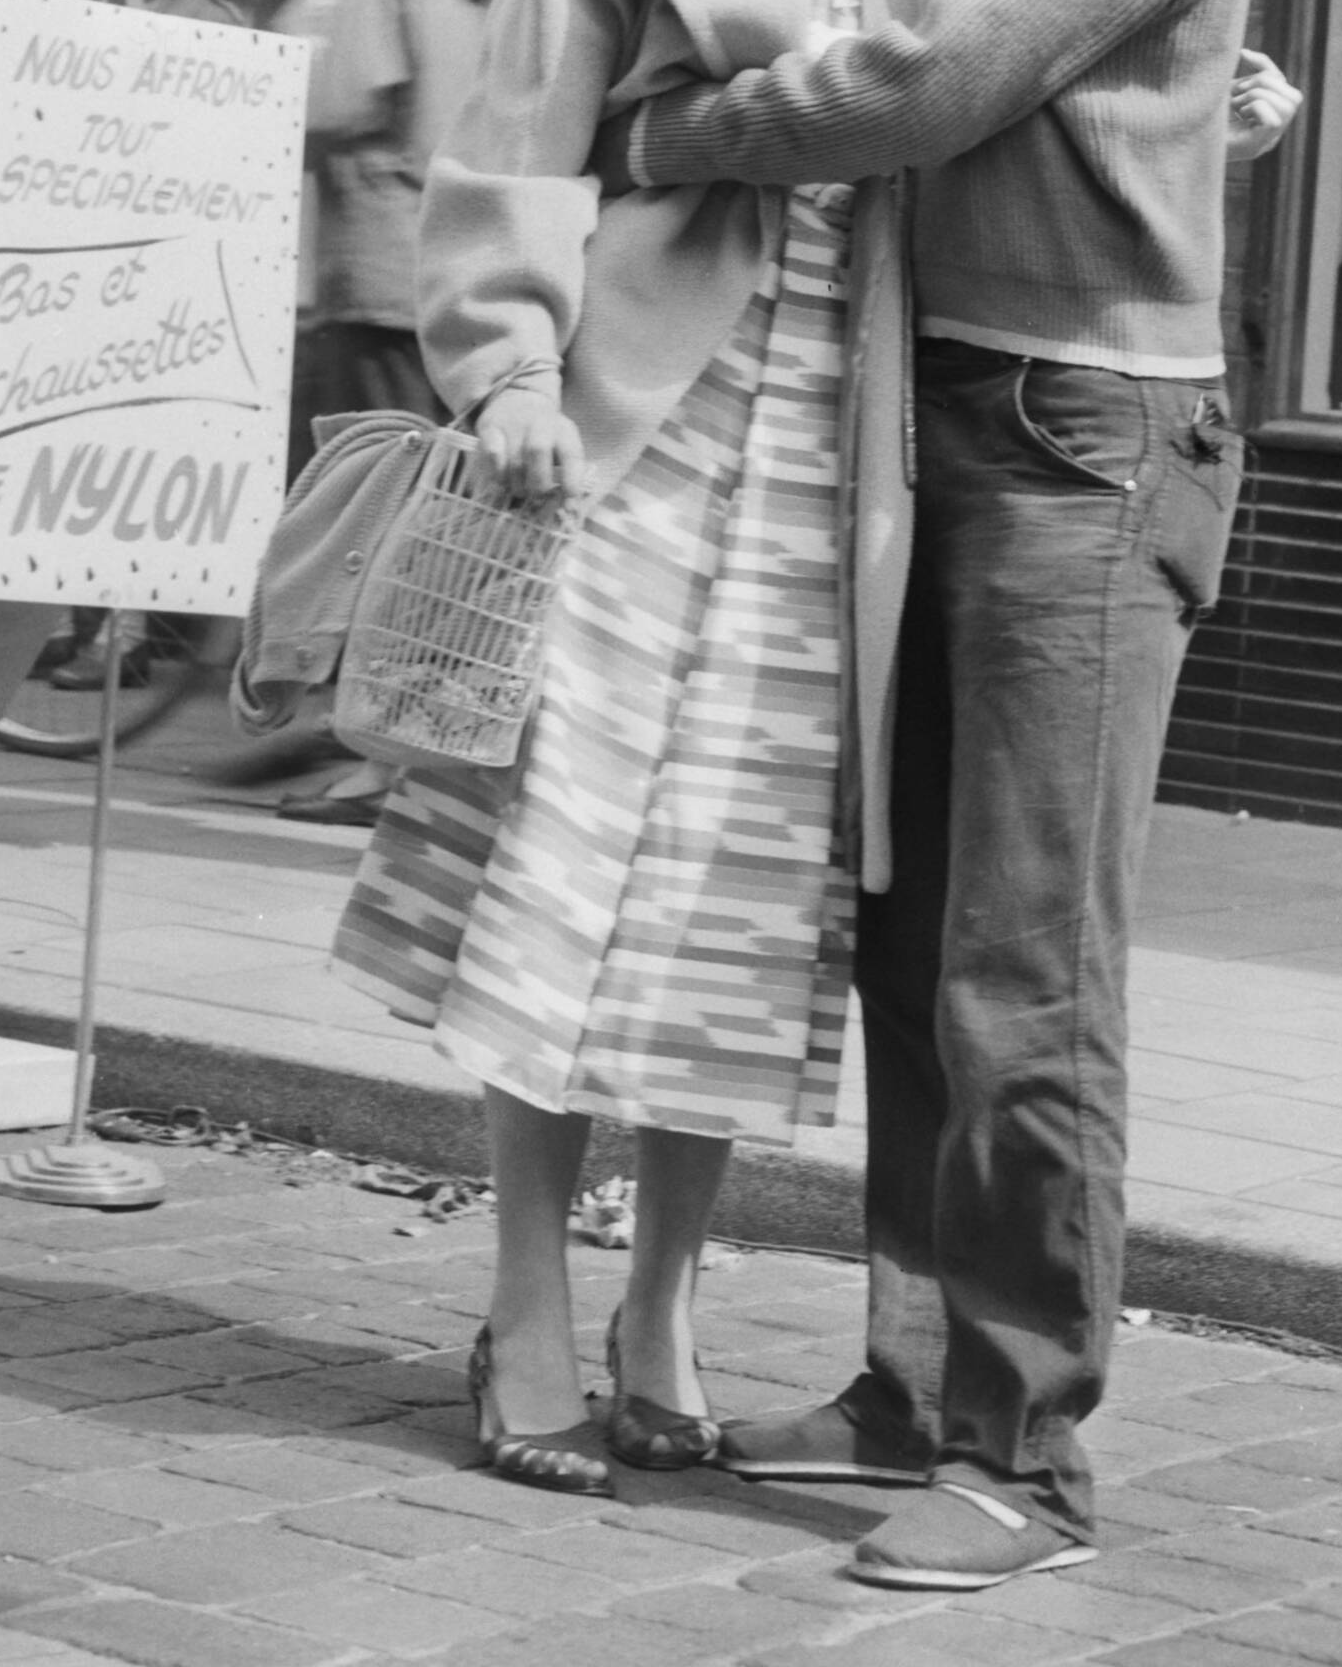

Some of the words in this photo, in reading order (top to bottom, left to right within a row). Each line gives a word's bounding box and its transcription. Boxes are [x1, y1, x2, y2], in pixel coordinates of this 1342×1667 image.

[12, 33, 120, 92] NOUS
[129, 51, 274, 108] AFFRONS
[78, 113, 173, 158] TOUT
[99, 249, 147, 308] et
[9, 442, 251, 547] NYLON
